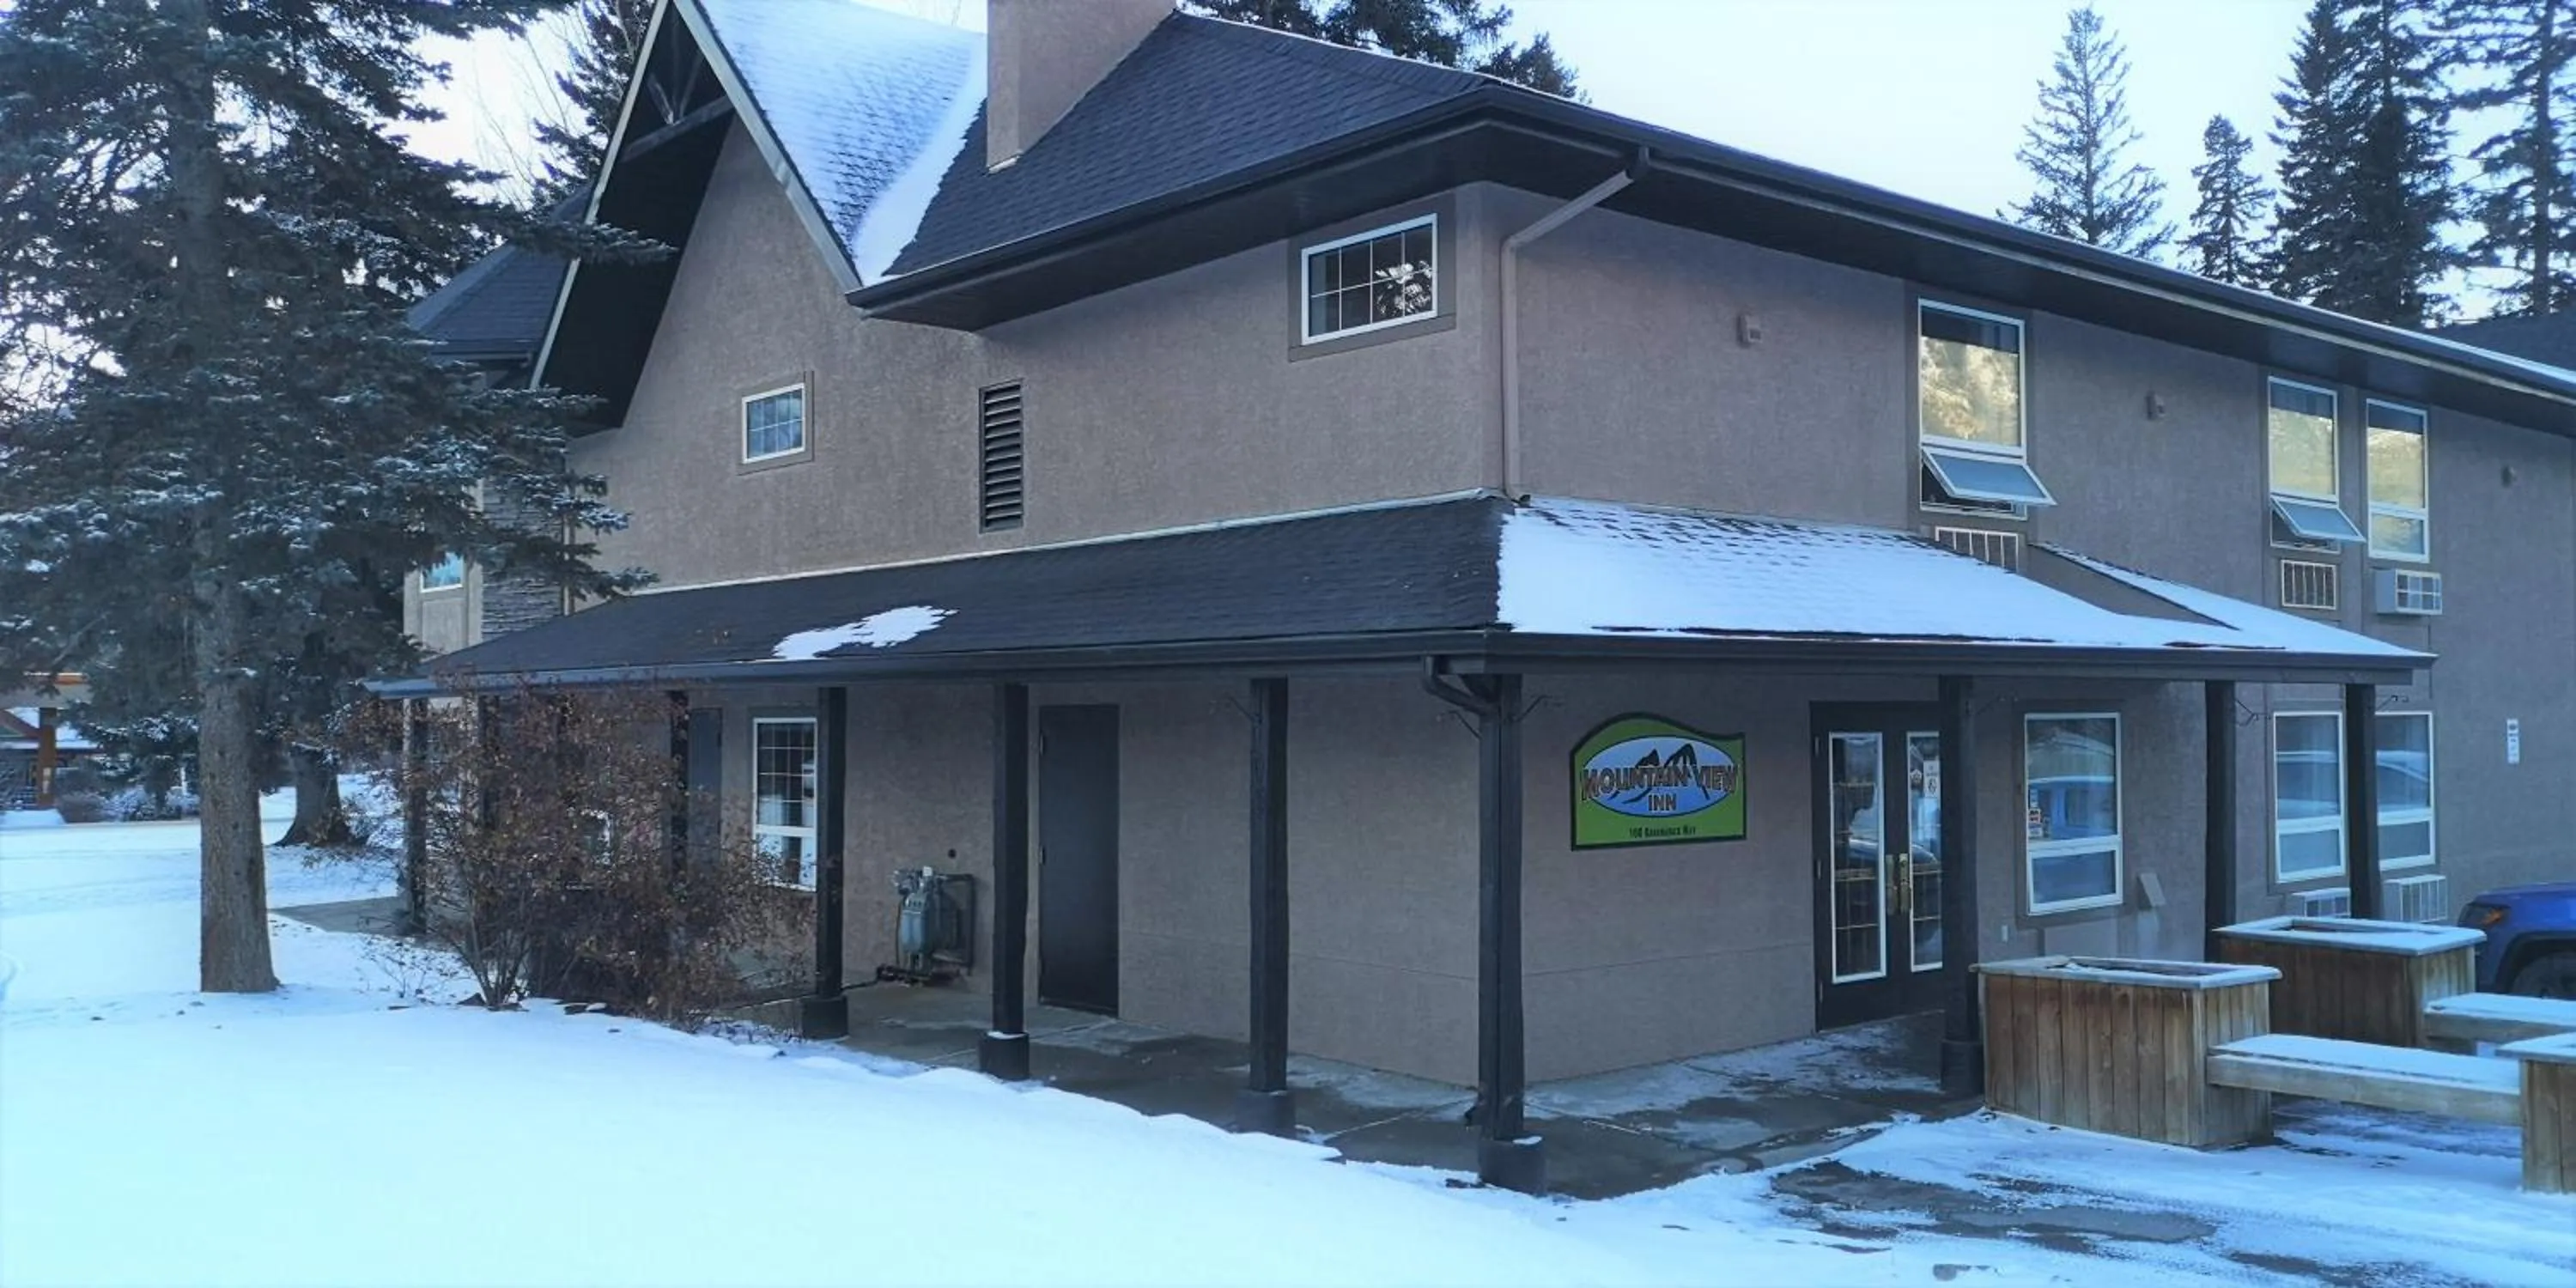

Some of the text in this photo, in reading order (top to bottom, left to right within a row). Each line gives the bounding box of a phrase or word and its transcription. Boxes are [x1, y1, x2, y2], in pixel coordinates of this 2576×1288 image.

[1580, 764, 1739, 801] MOUNTAIN VIEW
[1648, 793, 1678, 811] INN
